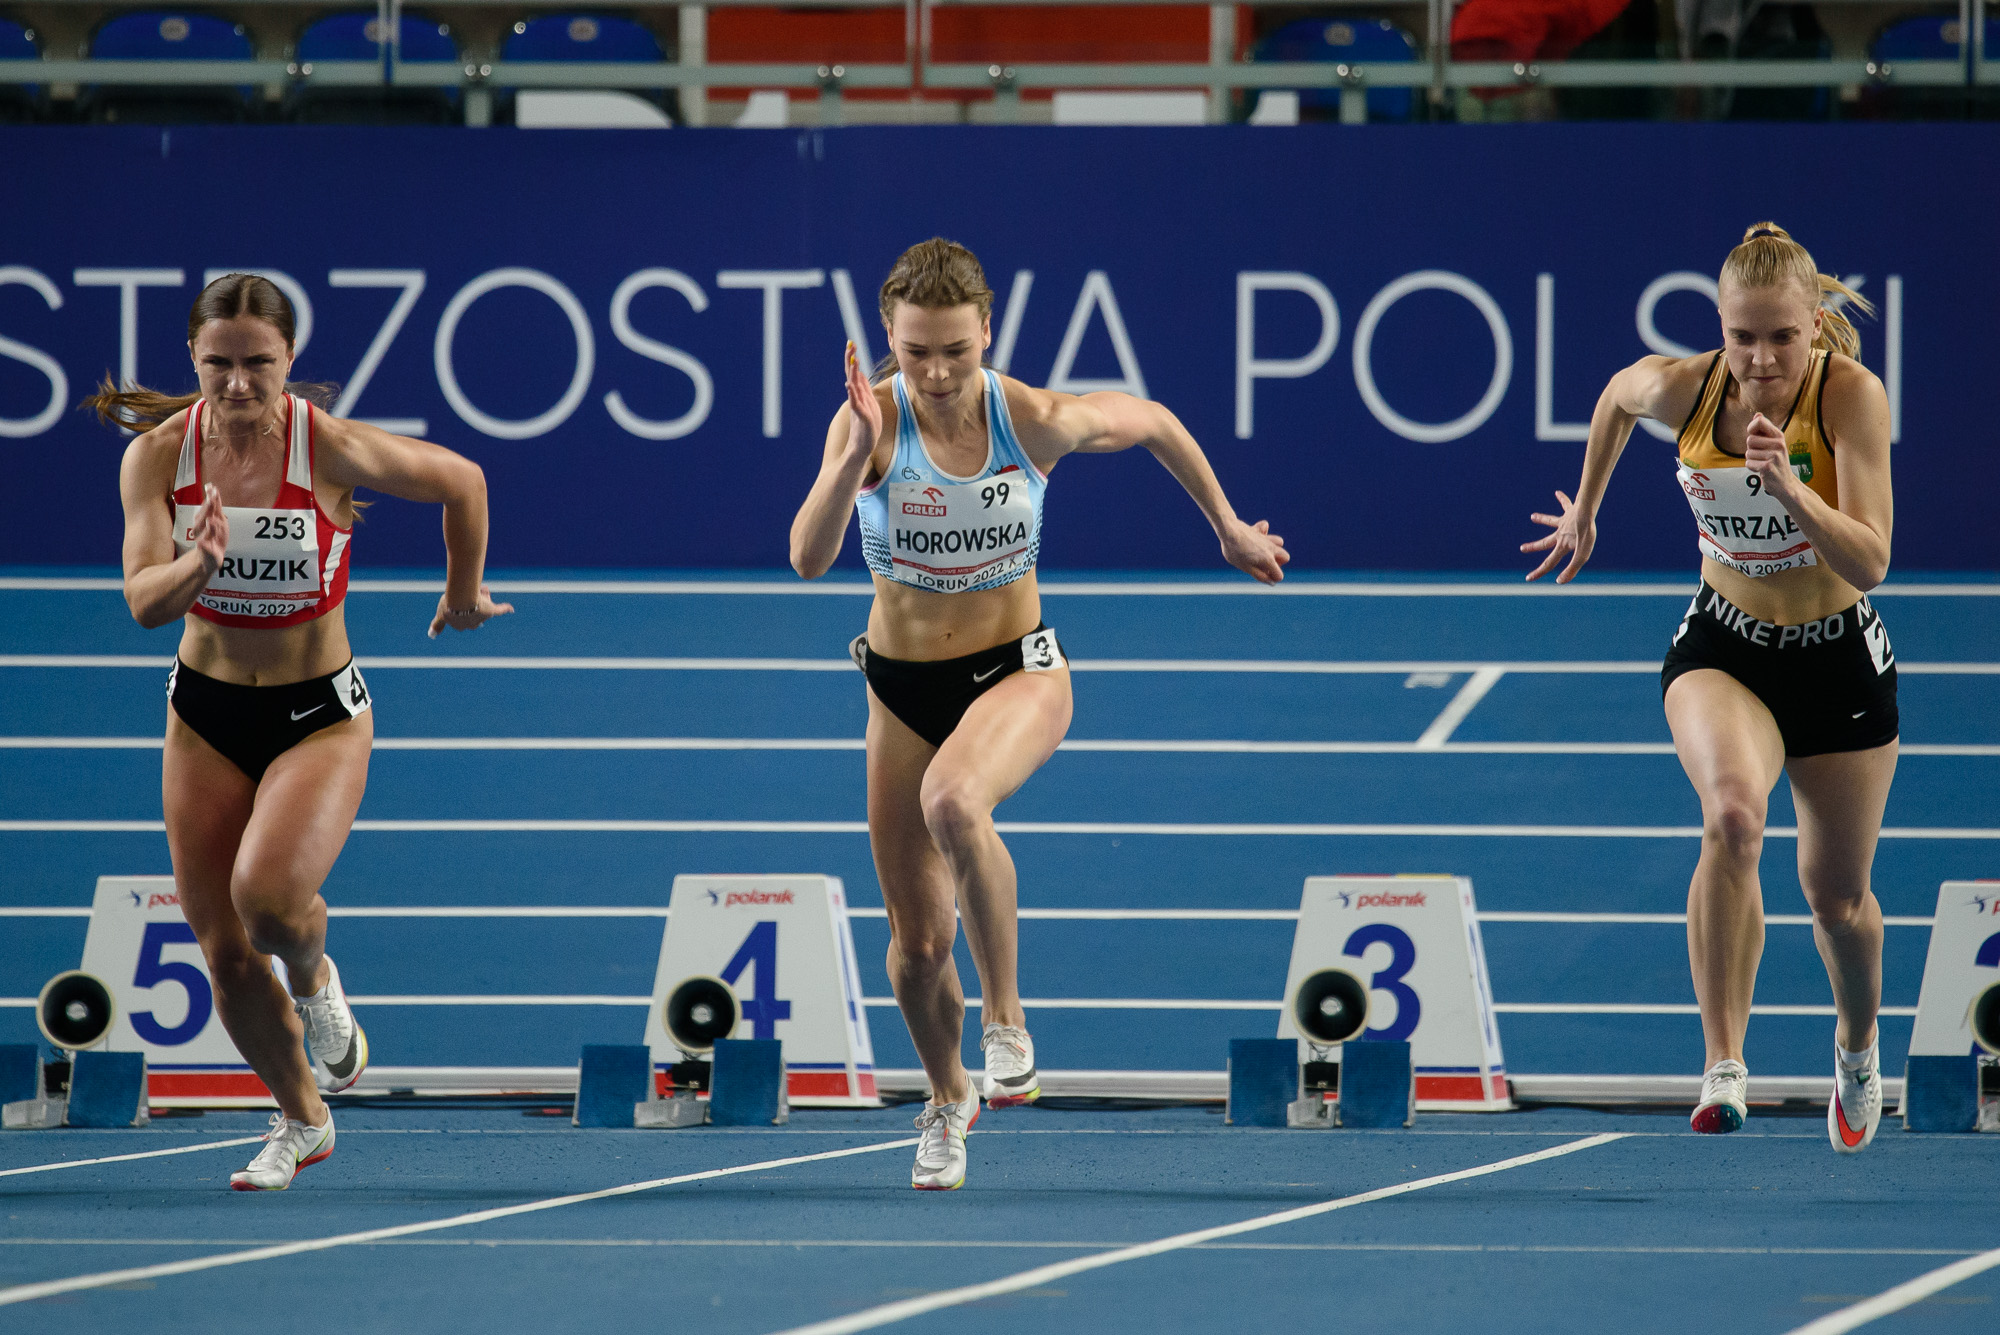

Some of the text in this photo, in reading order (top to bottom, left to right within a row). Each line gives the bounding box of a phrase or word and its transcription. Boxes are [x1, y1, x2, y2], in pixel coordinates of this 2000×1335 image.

[0, 267, 1903, 444] STZOSTA POLSI
[904, 504, 944, 516] ORLEN
[981, 482, 1010, 509] 99
[254, 516, 306, 541] 253
[895, 522, 1027, 555] HOROWSKA
[218, 557, 310, 581] RUZIK
[916, 573, 968, 591] TORUŃ
[973, 562, 1005, 584] 2022
[200, 596, 297, 615] TORUŃ 2022
[1705, 592, 1775, 647] NIKE
[1778, 613, 1845, 649] PRO
[1033, 635, 1054, 668] 3
[1874, 620, 1893, 667] 2
[350, 666, 369, 706] 4
[725, 889, 795, 908] polanik
[1356, 891, 1427, 909] polanik
[129, 922, 213, 1046] 5
[719, 921, 791, 1040] 4
[1341, 923, 1421, 1042] 3
